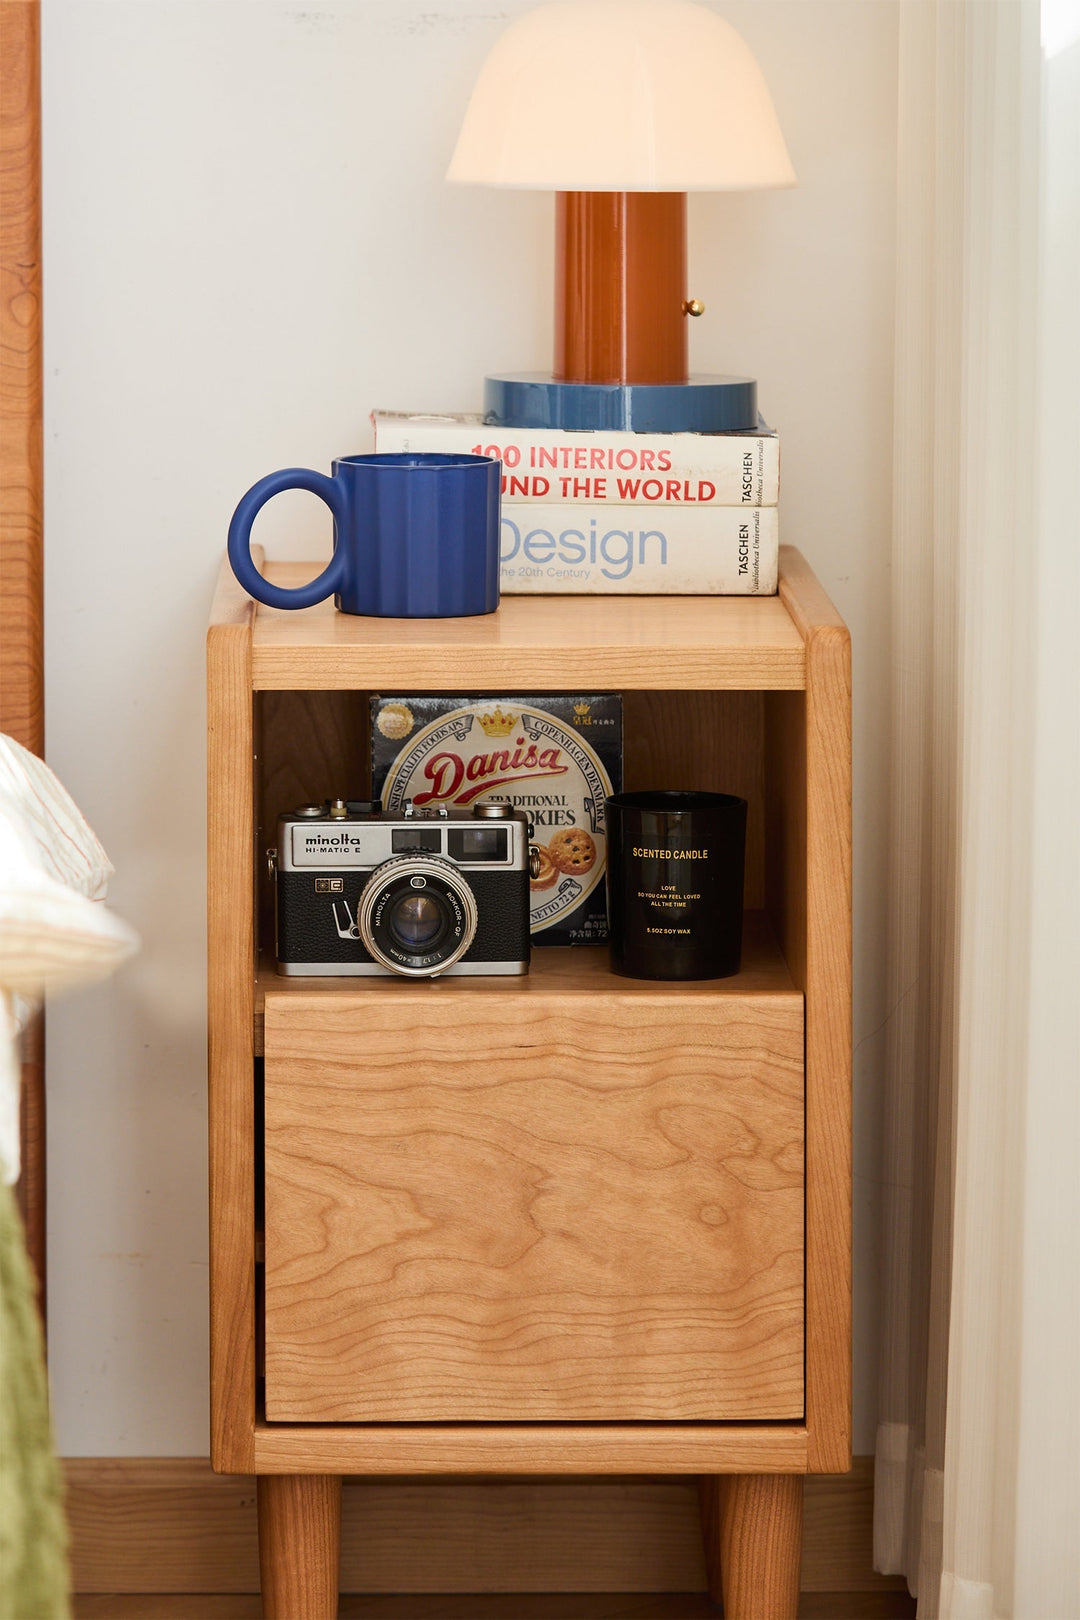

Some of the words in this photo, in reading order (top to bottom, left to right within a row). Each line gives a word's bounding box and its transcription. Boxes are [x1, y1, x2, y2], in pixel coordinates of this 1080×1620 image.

[530, 446, 672, 471] INTERIORS
[559, 477, 607, 498] THE
[616, 478, 716, 502] WORLD
[742, 452, 753, 503] TASCHEN
[738, 524, 749, 576] TASCHEN
[500, 566, 515, 577] he
[518, 567, 543, 577] 20th
[546, 567, 591, 580] Century
[534, 720, 592, 771] COPENHAGEN
[413, 737, 568, 806] Danisa
[305, 833, 361, 845] minolta
[632, 847, 672, 859] SCENTED
[673, 849, 708, 860] CANDLE
[375, 892, 391, 927] MINOLTA
[530, 902, 560, 921] NETTO
[559, 894, 570, 904] 72
